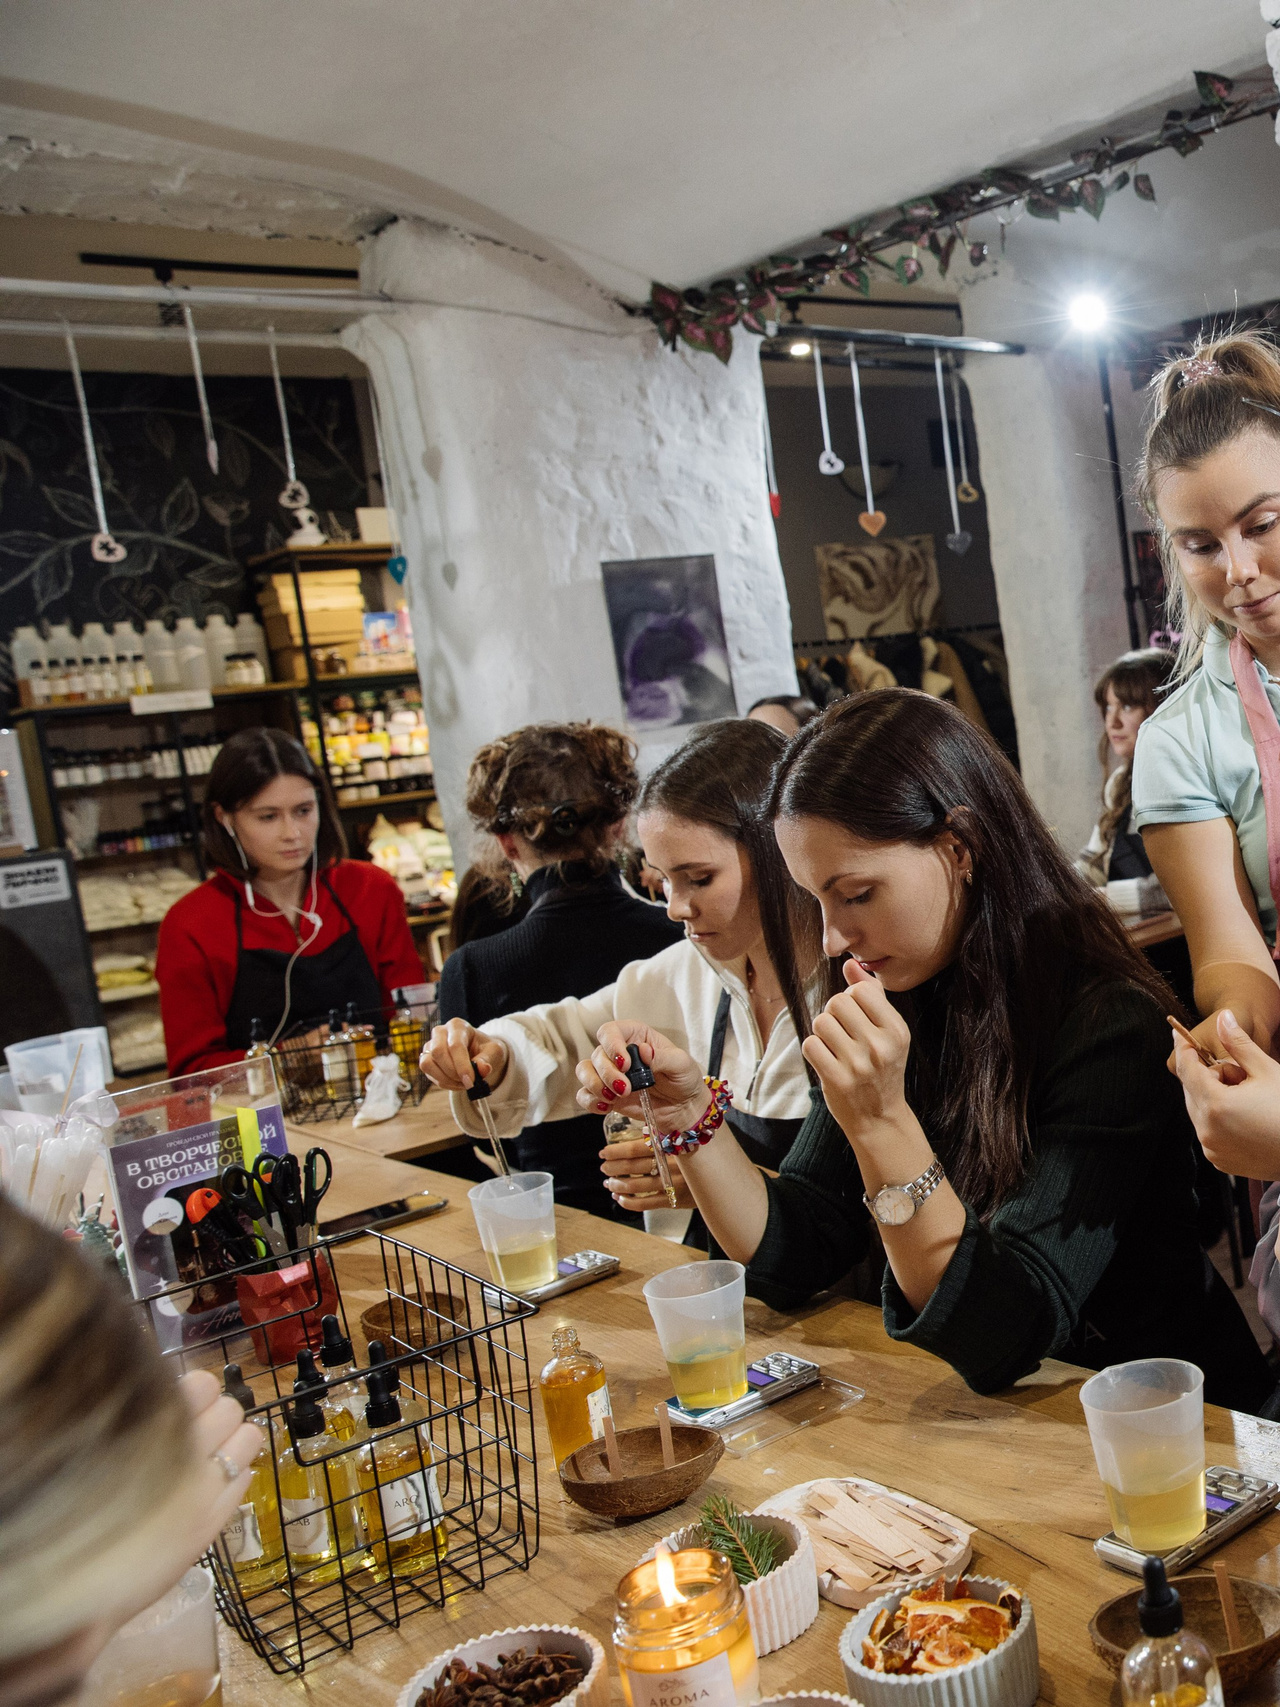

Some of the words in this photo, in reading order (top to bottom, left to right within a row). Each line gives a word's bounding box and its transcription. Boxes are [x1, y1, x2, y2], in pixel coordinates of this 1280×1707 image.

[166, 1136, 191, 1148] ПРОВЕДИ
[191, 1132, 209, 1142] СВОЙ
[126, 1162, 142, 1176] В
[137, 1143, 268, 1189] ОБСТАНОВЕ
[649, 1688, 710, 1707] AROMA
